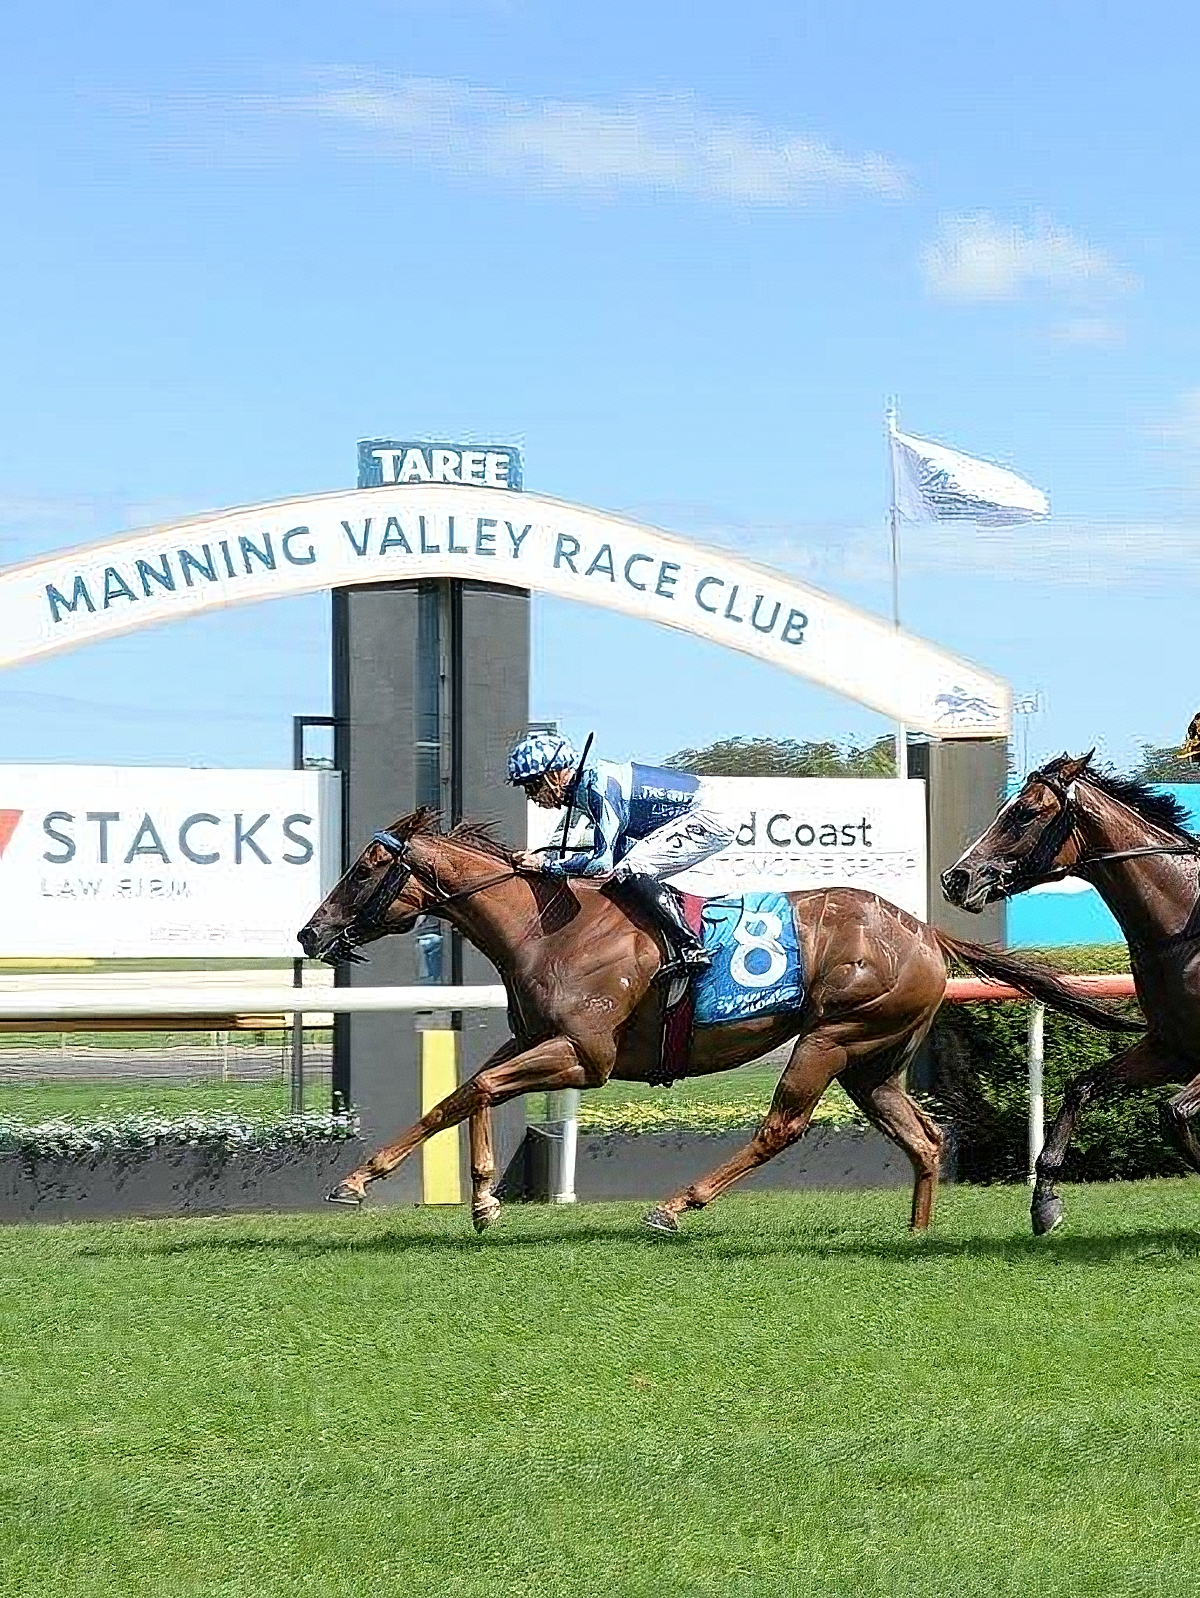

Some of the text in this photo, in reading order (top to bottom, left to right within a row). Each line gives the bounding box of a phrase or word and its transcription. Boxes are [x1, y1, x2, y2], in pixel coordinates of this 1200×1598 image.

[372, 448, 511, 484] TAREE
[45, 515, 809, 646] MANNING VALLEY RACE CLUB
[42, 811, 315, 865] STACKS
[766, 813, 873, 847] Coast
[41, 878, 103, 898] LAW
[730, 909, 788, 988] 8
